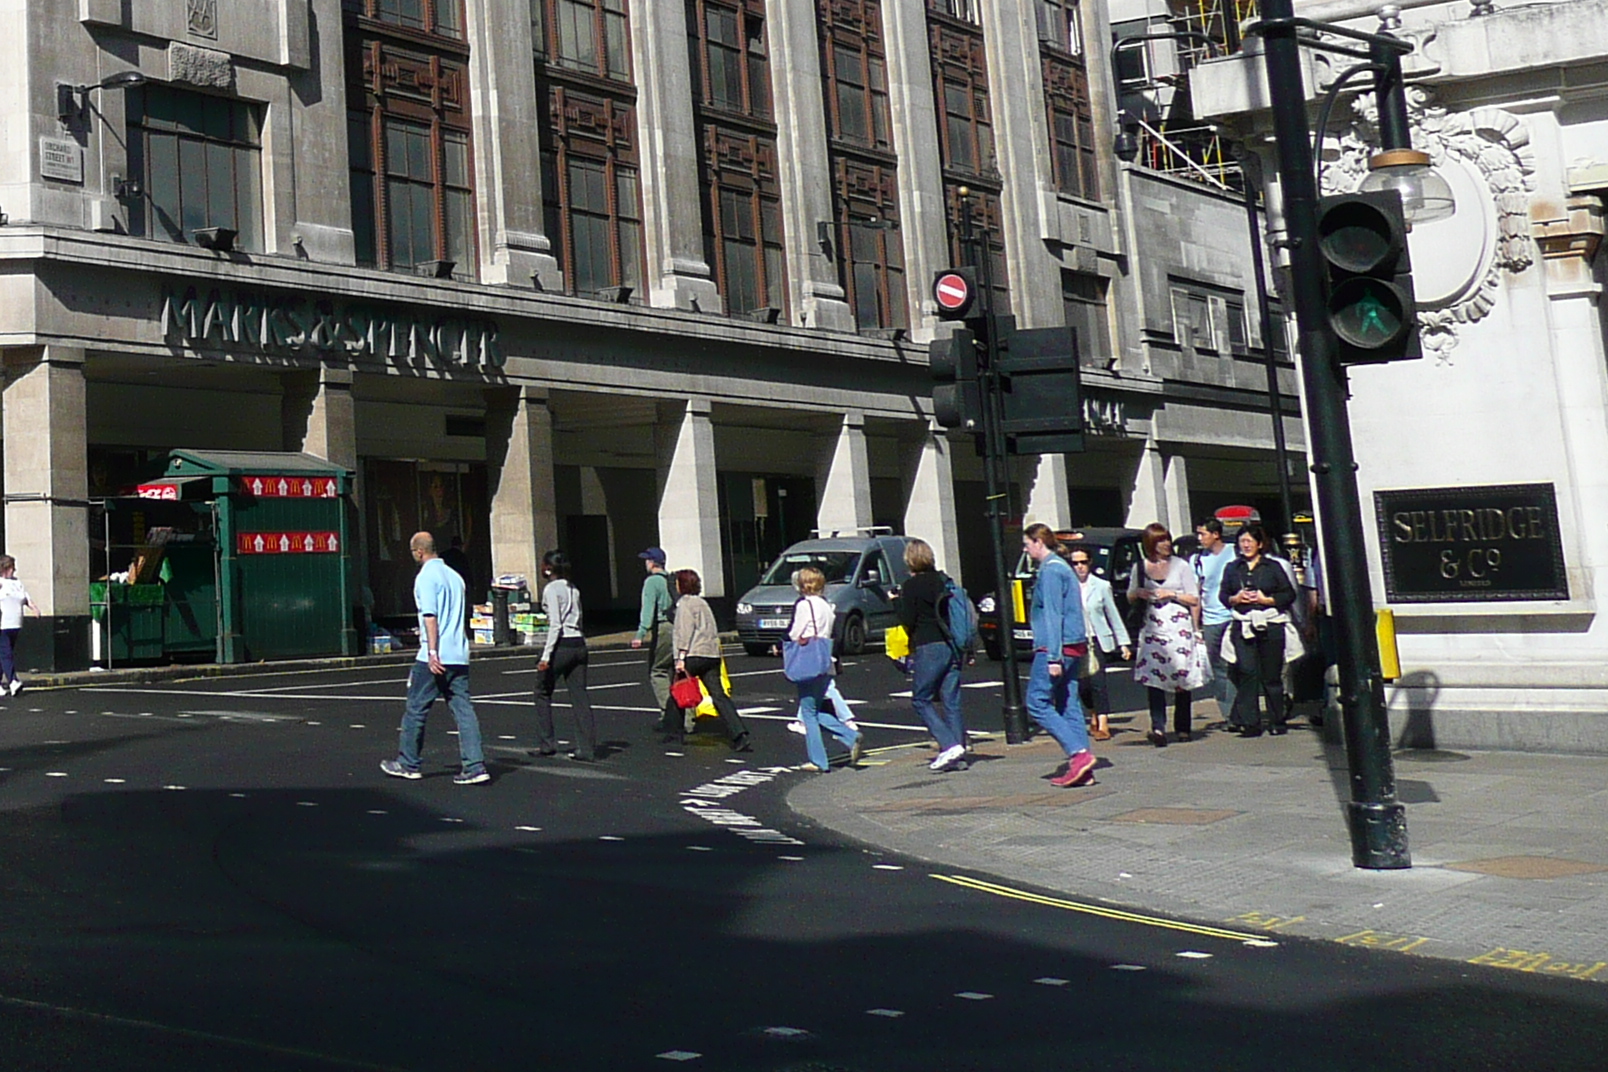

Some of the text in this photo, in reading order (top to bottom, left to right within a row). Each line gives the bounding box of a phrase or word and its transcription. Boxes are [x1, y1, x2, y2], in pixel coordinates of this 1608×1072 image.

[45, 152, 66, 163] STREET
[1394, 506, 1544, 543] SELFRIDGE
[1440, 549, 1460, 579] &
